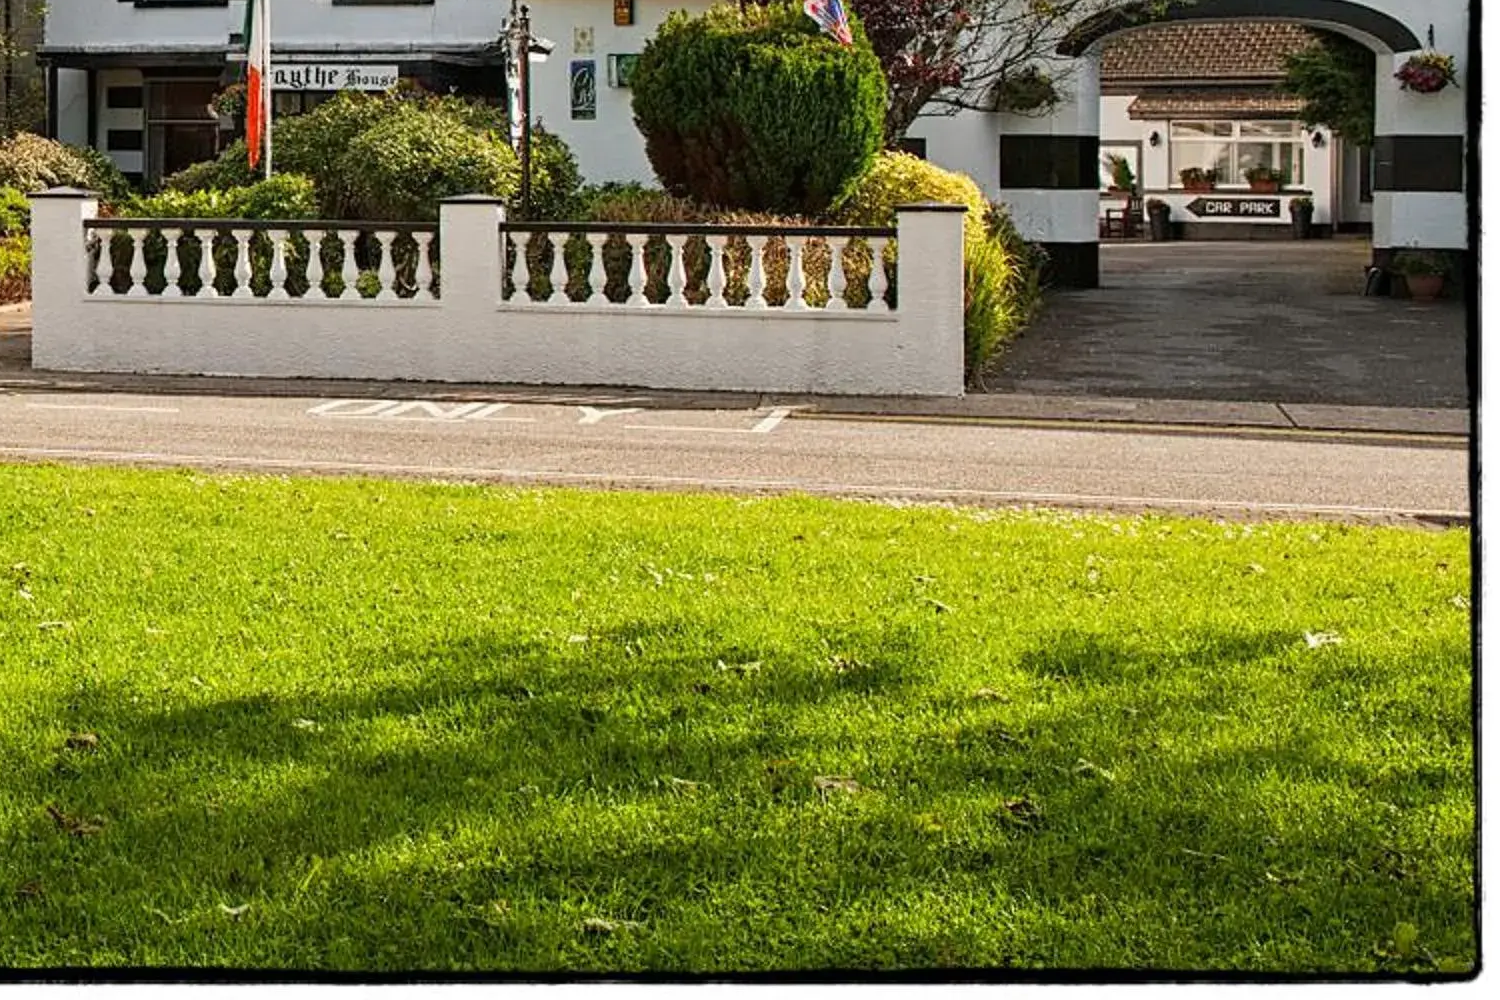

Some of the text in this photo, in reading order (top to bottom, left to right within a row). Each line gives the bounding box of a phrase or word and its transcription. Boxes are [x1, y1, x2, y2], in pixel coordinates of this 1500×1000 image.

[268, 65, 339, 89] aythe
[1205, 201, 1275, 215] CAR PARK
[305, 400, 643, 424] ONLY
